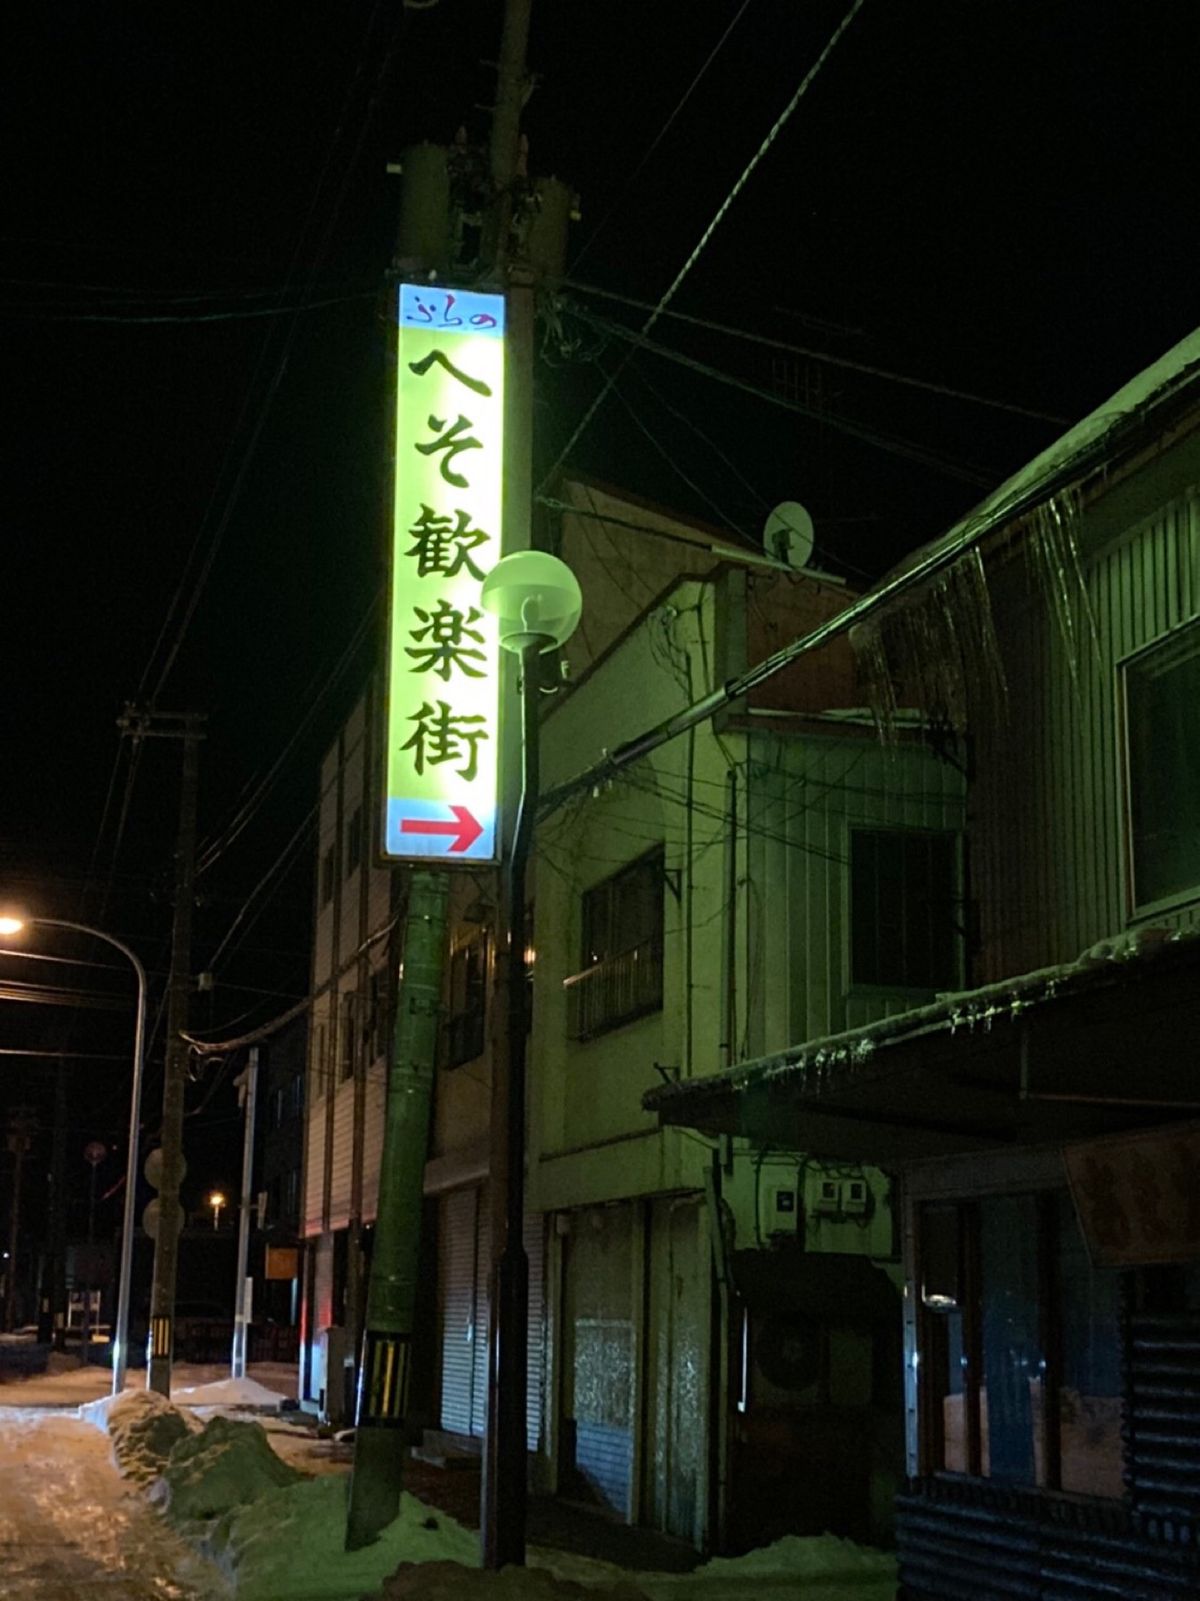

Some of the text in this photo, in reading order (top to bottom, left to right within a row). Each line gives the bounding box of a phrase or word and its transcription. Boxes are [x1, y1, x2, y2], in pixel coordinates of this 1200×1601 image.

[400, 349, 493, 783] へそ歓楽街
